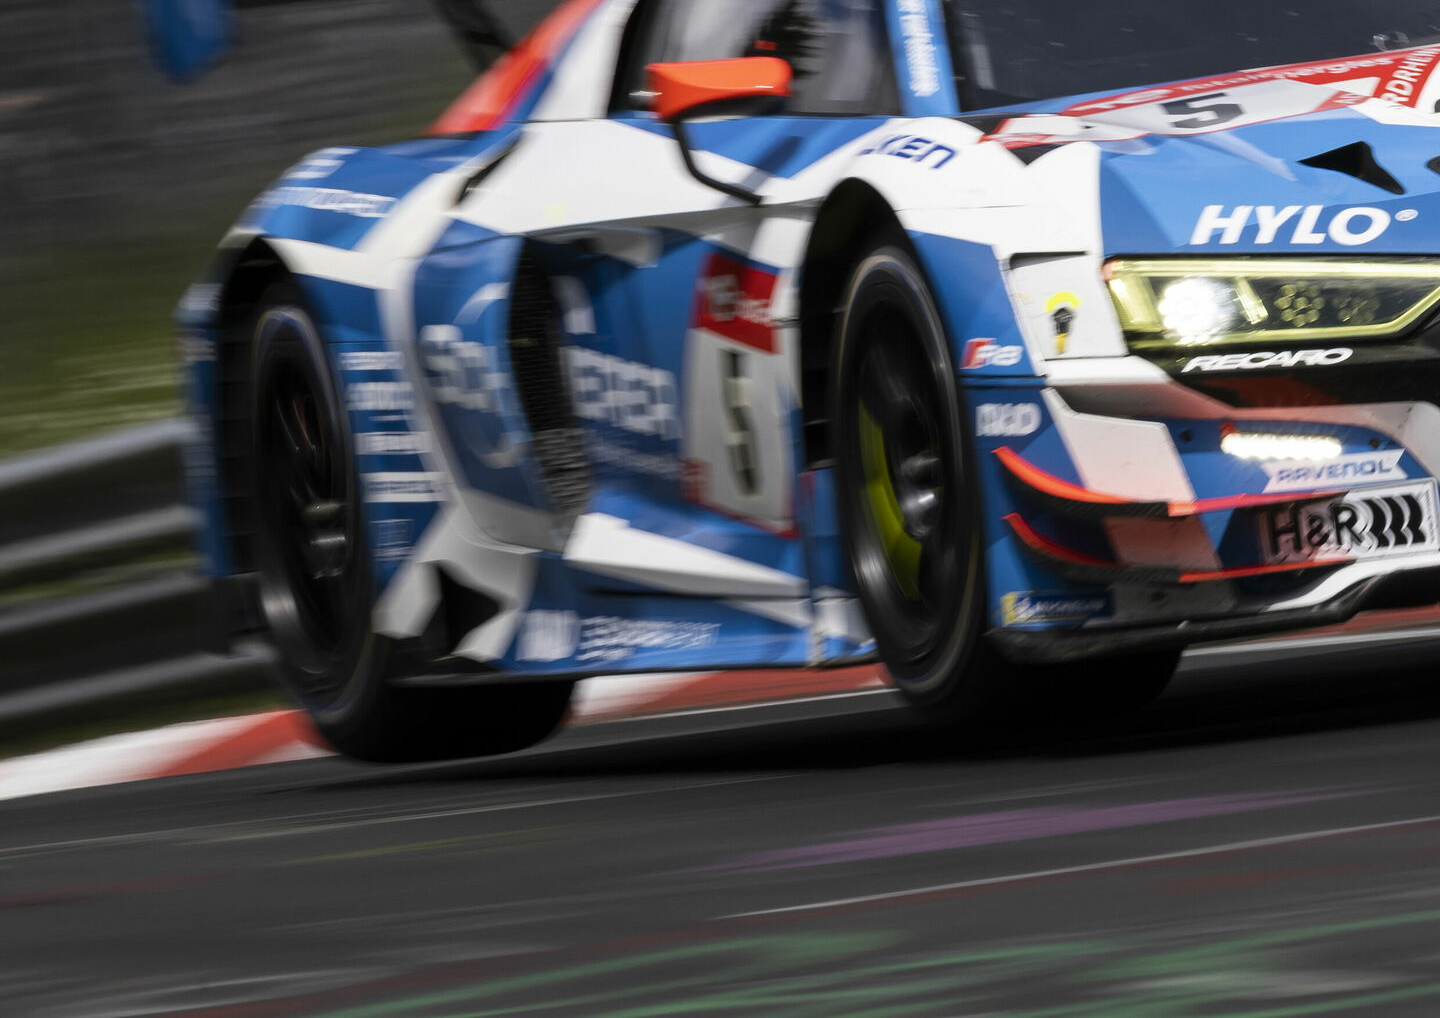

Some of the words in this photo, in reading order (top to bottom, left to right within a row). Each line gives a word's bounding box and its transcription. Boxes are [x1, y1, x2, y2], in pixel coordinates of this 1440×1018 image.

[1161, 92, 1244, 129] 5
[1189, 204, 1391, 246] HYLO
[1181, 347, 1354, 374] RECARO
[1276, 459, 1393, 482] RAVENOL
[1267, 501, 1366, 557] H&R
